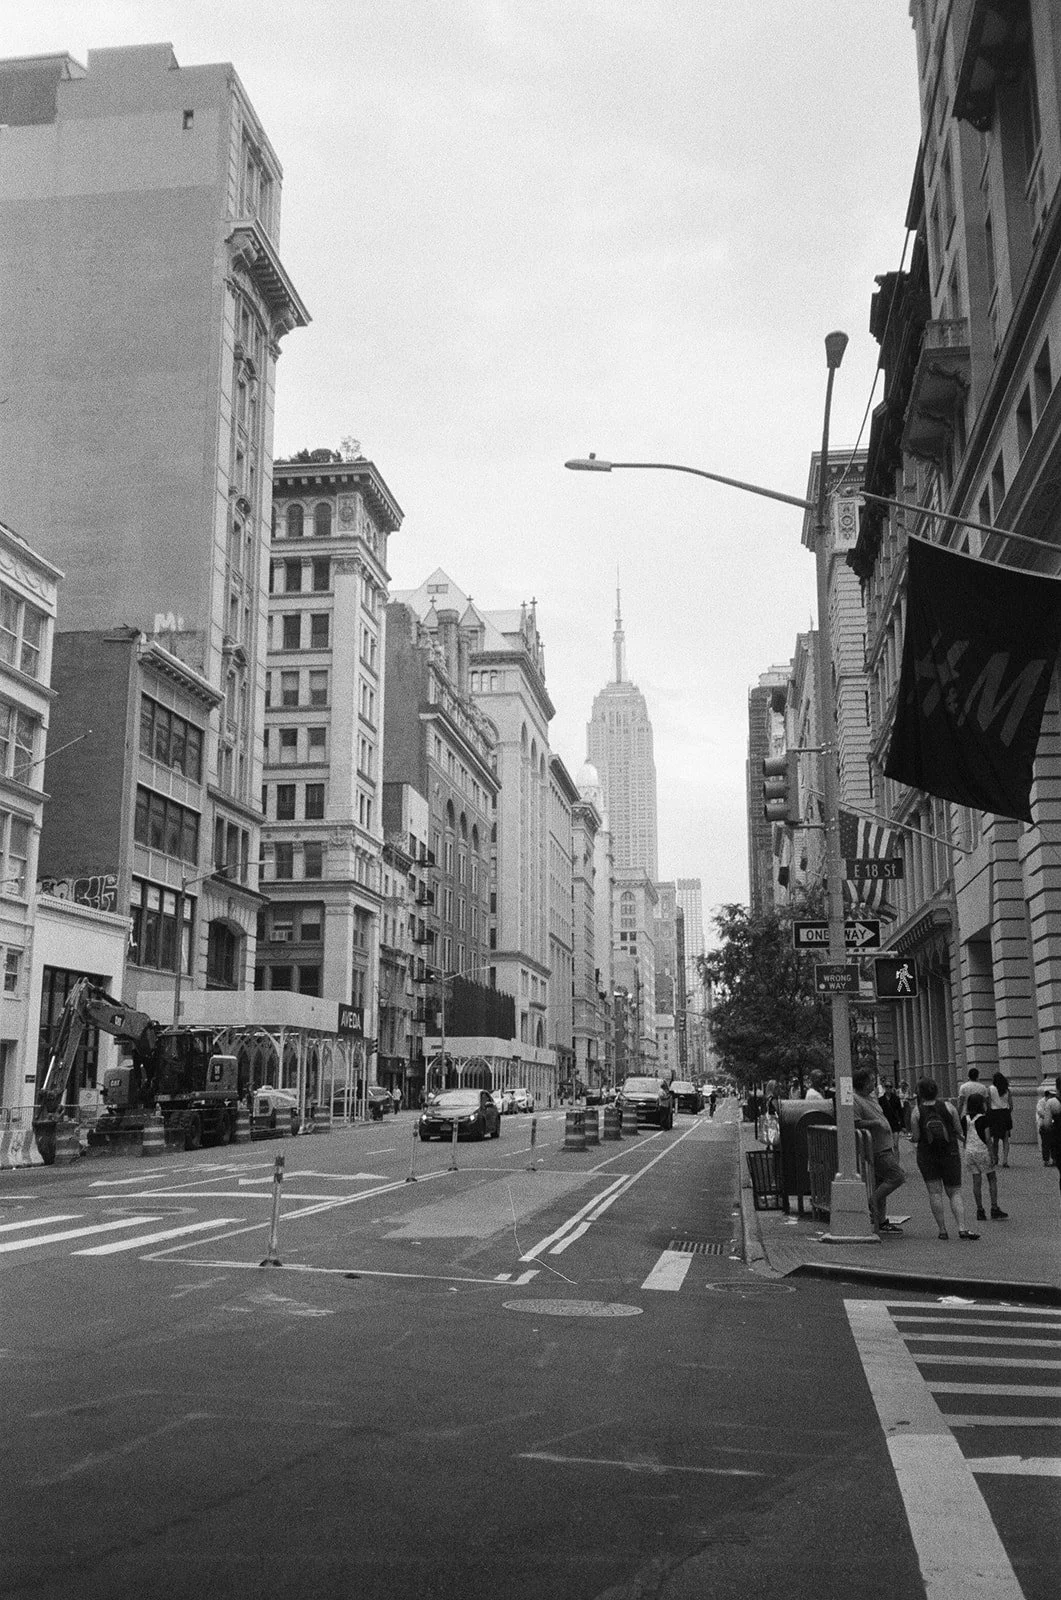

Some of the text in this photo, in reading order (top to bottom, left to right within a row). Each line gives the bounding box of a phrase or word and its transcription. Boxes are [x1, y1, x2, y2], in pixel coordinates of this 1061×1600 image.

[854, 863, 897, 877] E 18 St
[806, 929, 829, 941] ONE
[823, 974, 852, 982] WRONG
